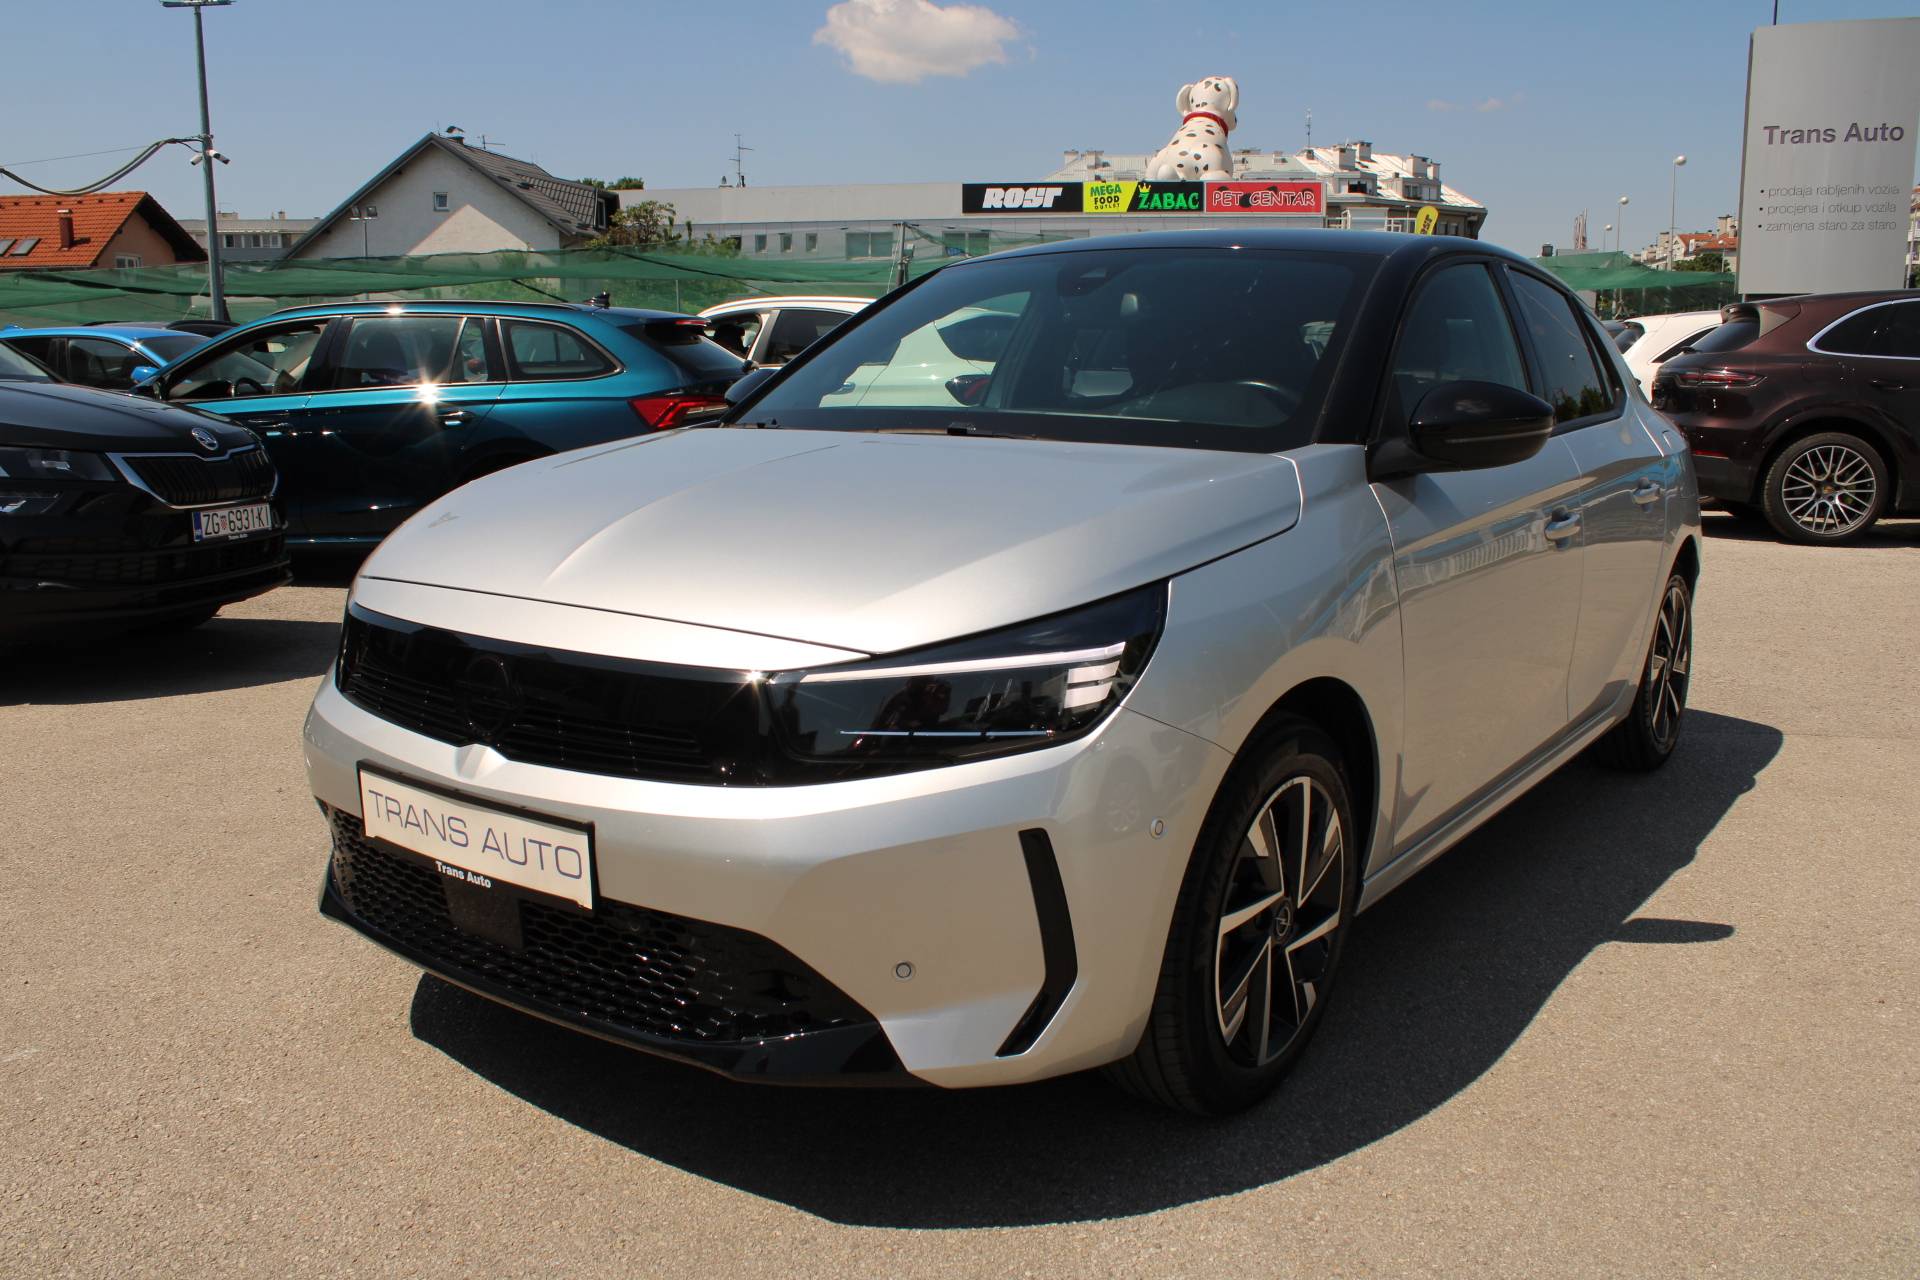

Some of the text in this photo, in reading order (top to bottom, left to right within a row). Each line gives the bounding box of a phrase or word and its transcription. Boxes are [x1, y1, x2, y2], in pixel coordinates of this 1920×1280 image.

[1763, 122, 1905, 145] Trans Auto
[982, 187, 1063, 209] ROST
[1090, 184, 1122, 197] MEGA
[1212, 190, 1316, 207] PET CENTAR
[1768, 184, 1900, 199] prodaja rabljenih vozila
[1094, 196, 1120, 205] FOOD
[1767, 204, 1818, 216] procjena
[1828, 203, 1862, 215] otkup
[1865, 202, 1897, 213] vozila
[1765, 219, 1897, 233] zamjena staro za staro
[202, 513, 220, 536] ZG
[368, 789, 583, 880] TRANS AUTO
[435, 860, 491, 889] Trans Auto
